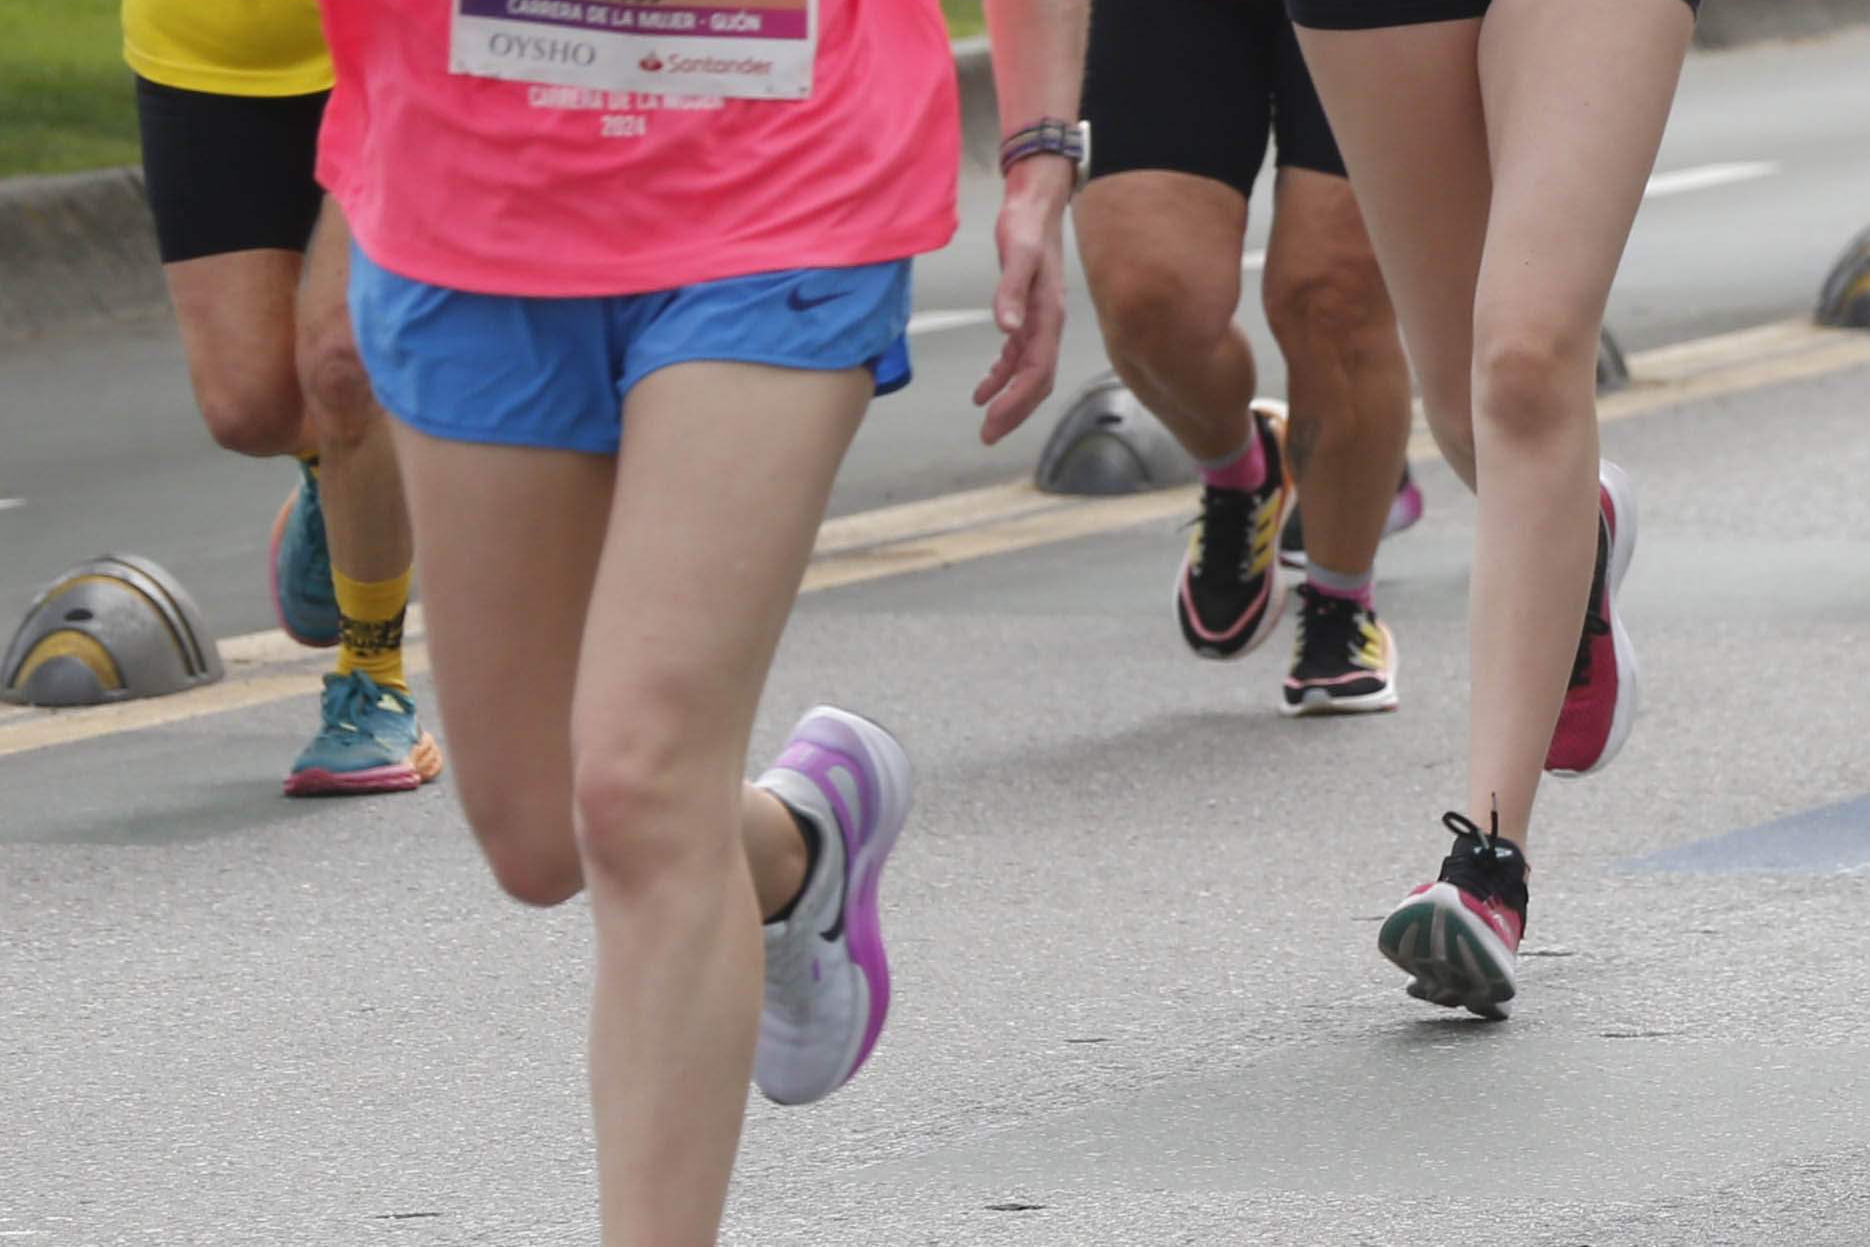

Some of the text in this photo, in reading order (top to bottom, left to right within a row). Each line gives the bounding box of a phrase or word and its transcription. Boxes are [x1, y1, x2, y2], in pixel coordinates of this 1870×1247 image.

[585, 4, 609, 25] DE
[612, 7, 635, 27] LA
[638, 8, 696, 30] MUJER
[710, 8, 763, 32] GIJÓN
[488, 32, 598, 68] OYSHO
[667, 53, 773, 76] Santander
[601, 114, 647, 138] 2024
